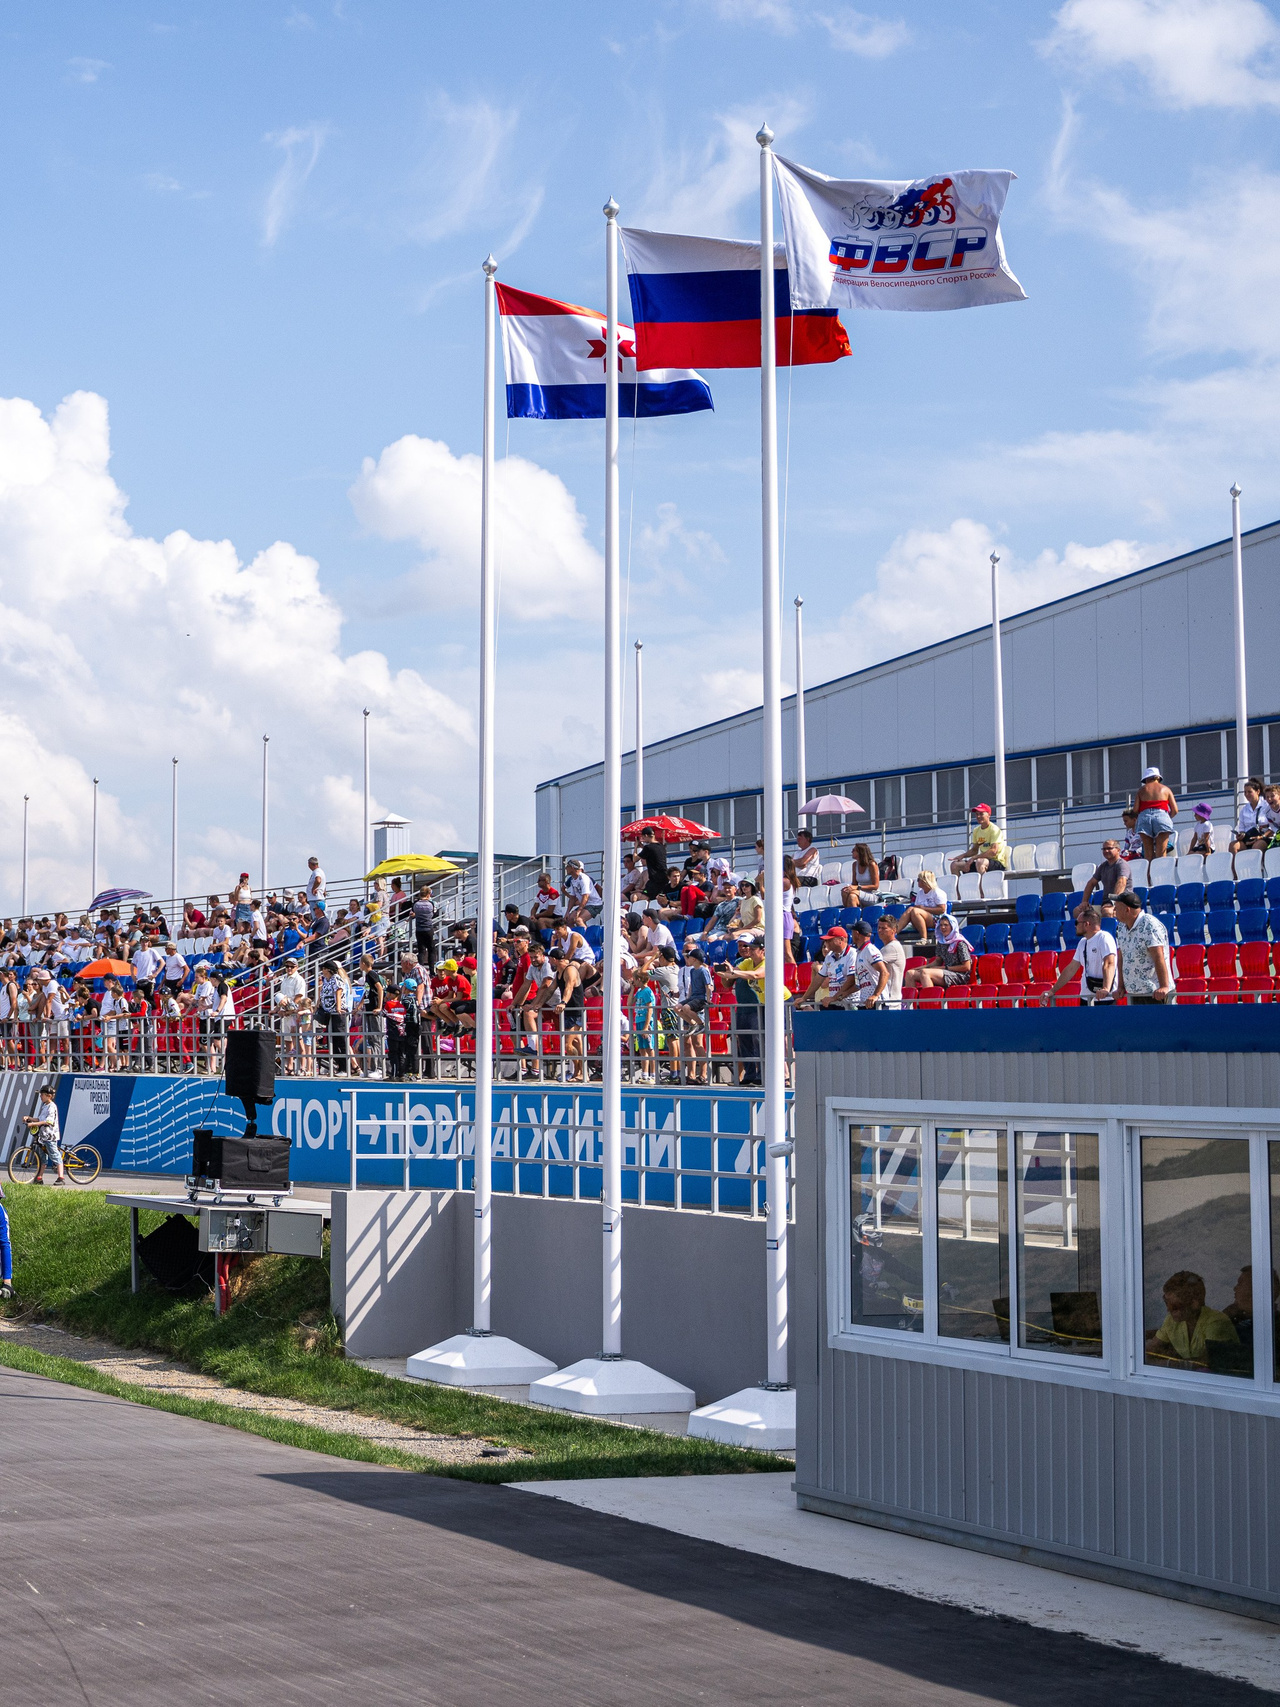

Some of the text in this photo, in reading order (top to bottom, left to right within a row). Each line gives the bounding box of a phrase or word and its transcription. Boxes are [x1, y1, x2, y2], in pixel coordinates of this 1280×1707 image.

[828, 227, 988, 275] ФВСР
[870, 279, 935, 288] Велосипедного
[937, 275, 969, 285] Спорта
[90, 1091, 110, 1102] ПРОЕКТЫ
[93, 1103, 110, 1114] РОССИИ
[272, 1097, 351, 1150] СПОРТ
